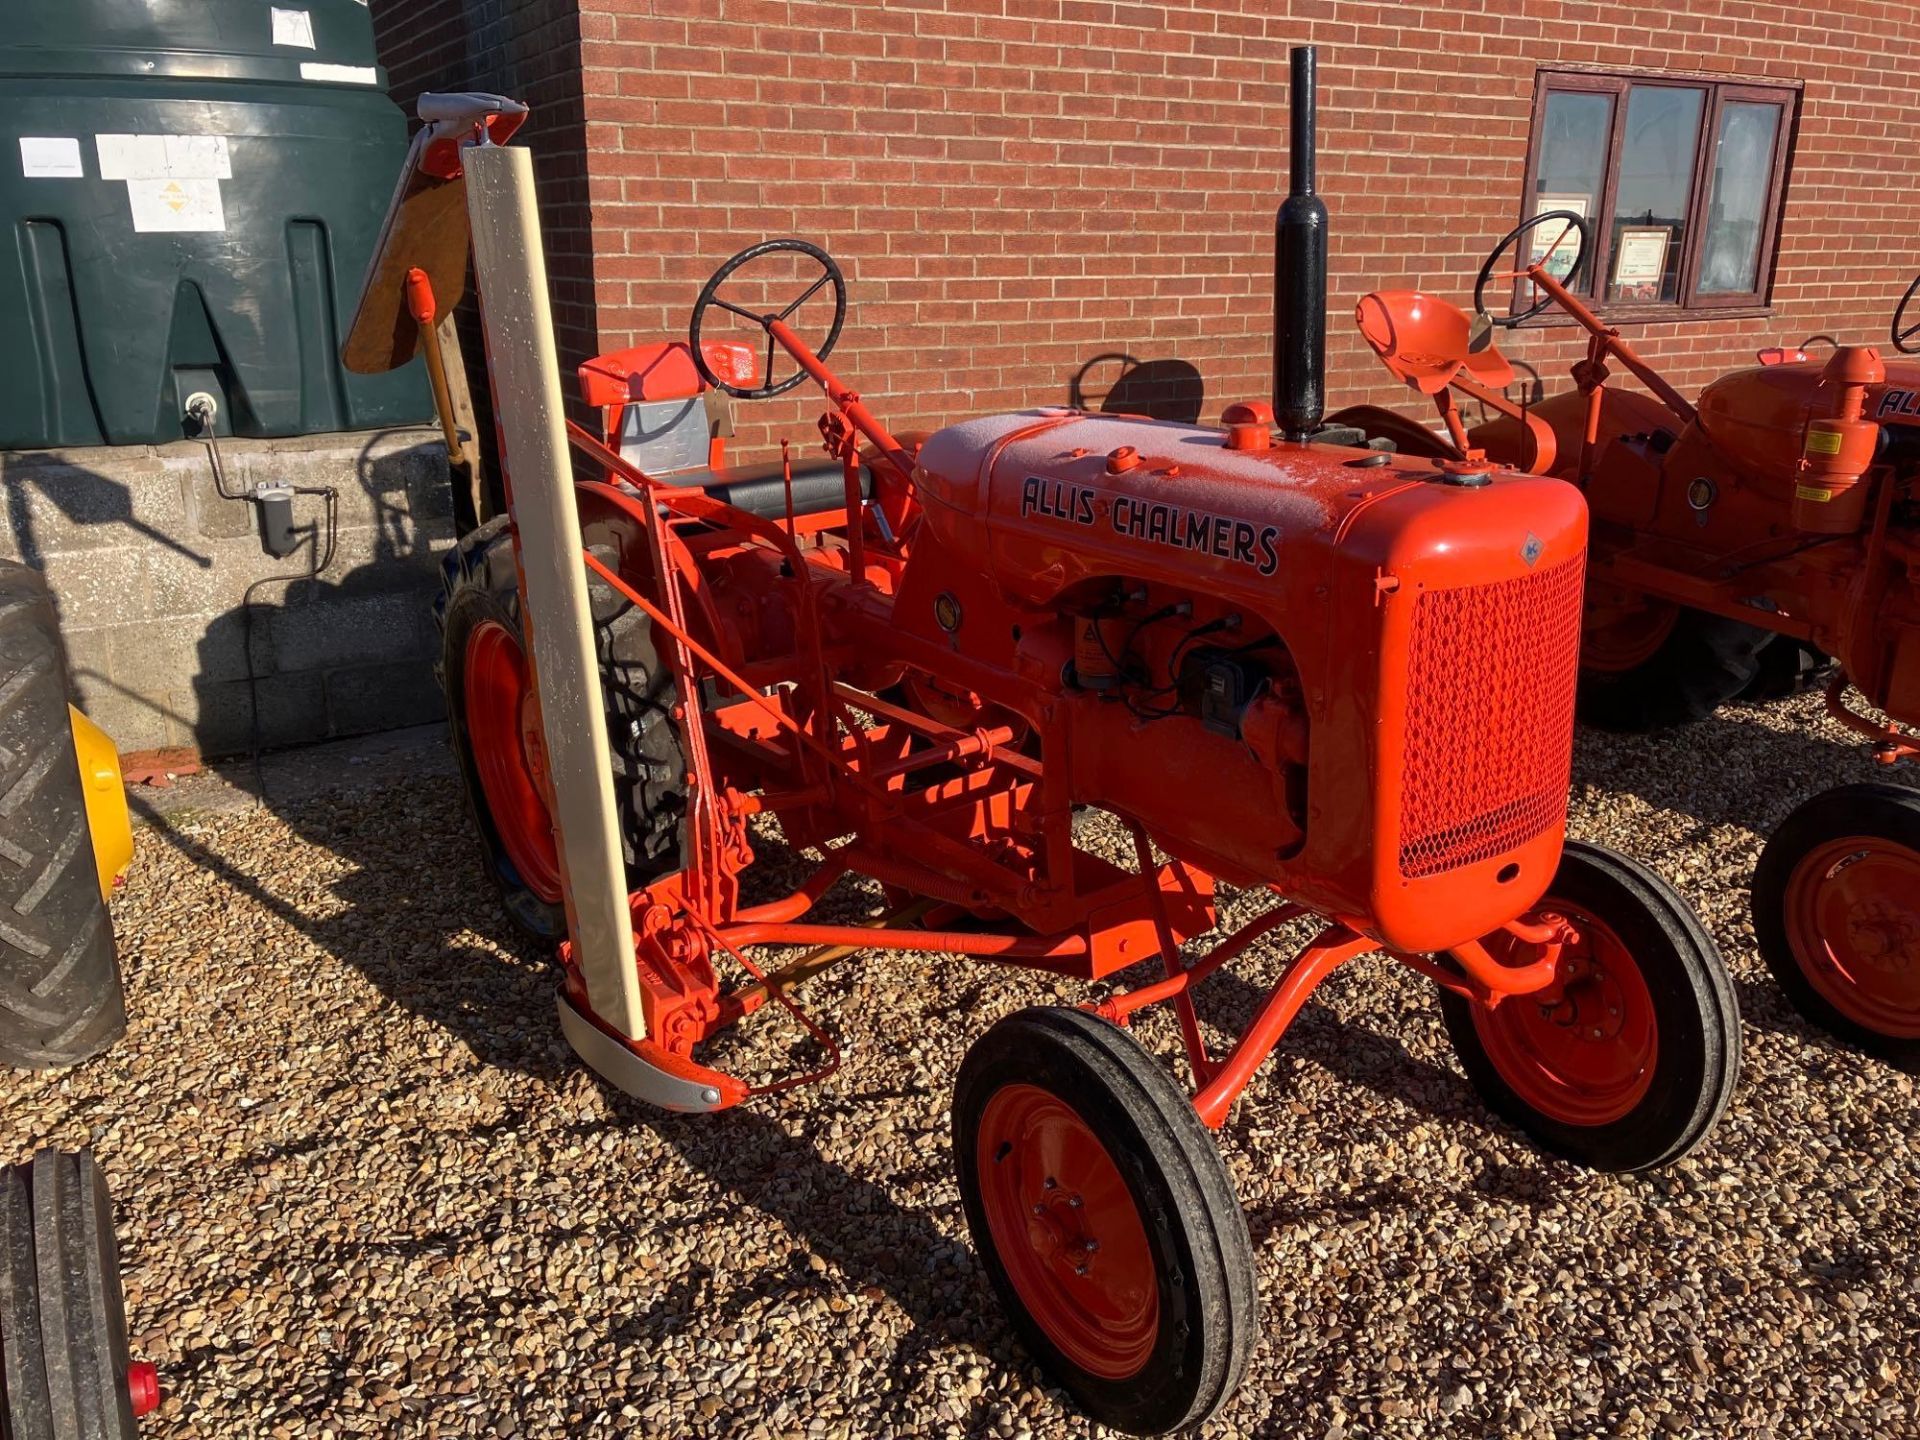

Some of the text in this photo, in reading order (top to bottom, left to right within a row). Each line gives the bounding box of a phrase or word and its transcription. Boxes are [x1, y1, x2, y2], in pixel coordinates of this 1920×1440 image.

[1876, 389, 1920, 418] AL
[1022, 476, 1280, 576] ALLIS CHALMERS
